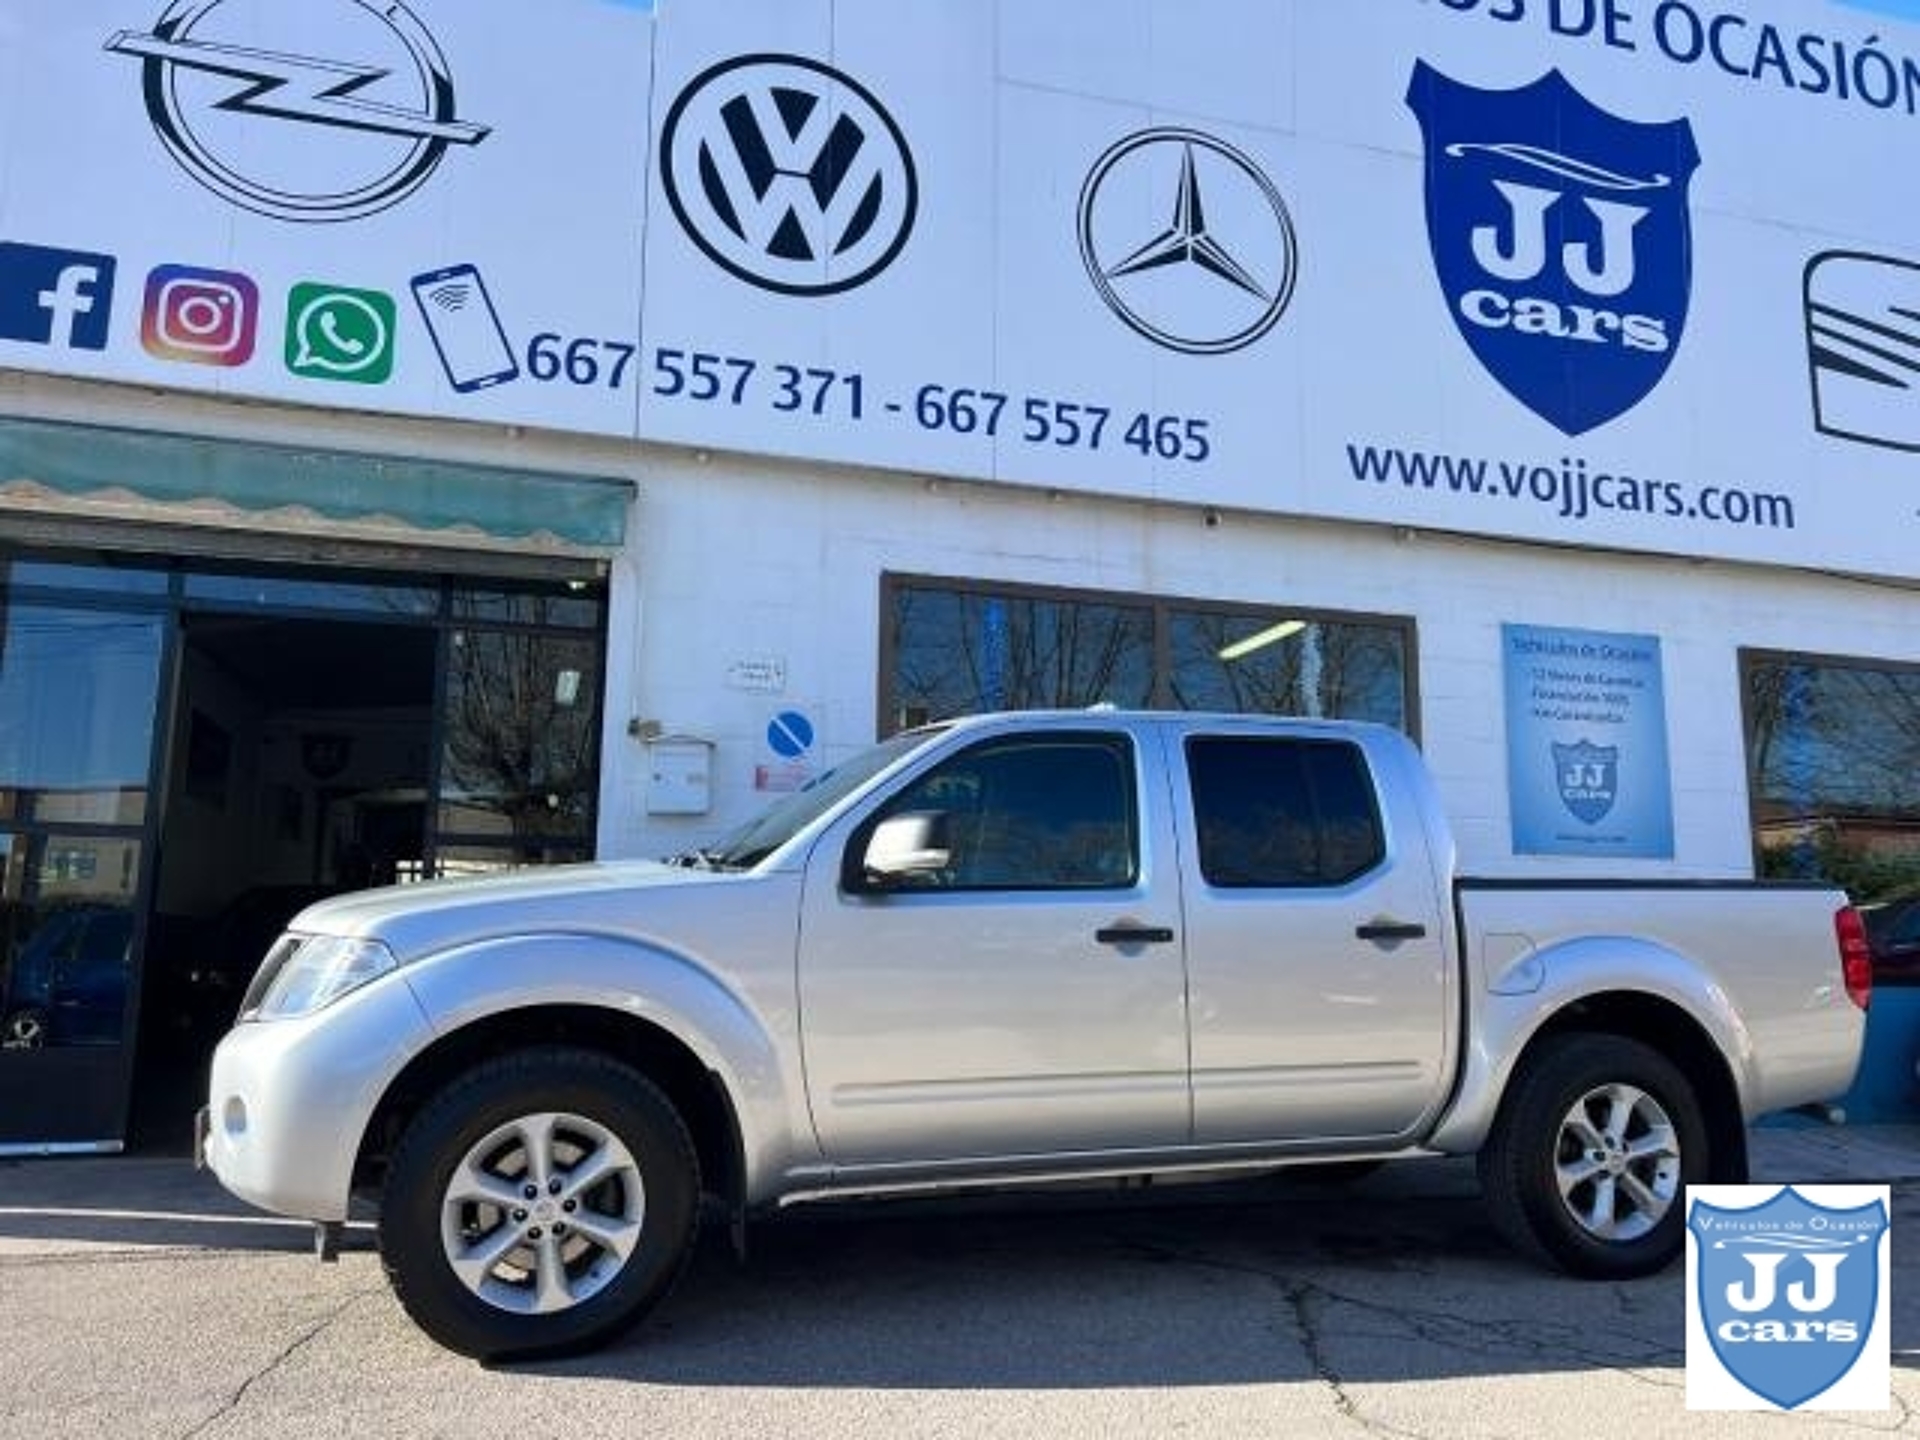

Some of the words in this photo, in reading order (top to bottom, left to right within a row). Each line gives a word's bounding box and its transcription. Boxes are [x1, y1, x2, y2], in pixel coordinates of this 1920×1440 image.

[1549, 0, 1636, 51] DE
[1470, 179, 1651, 296] JJ
[1459, 289, 1668, 353] cars
[527, 333, 636, 389] 667
[653, 348, 756, 405] 557
[773, 364, 864, 419] 371
[916, 384, 1007, 436] 667
[1023, 399, 1110, 449] 557
[1124, 412, 1211, 462] 465
[1346, 443, 1795, 529] www.vojjcars.com
[1565, 763, 1606, 787] JJ
